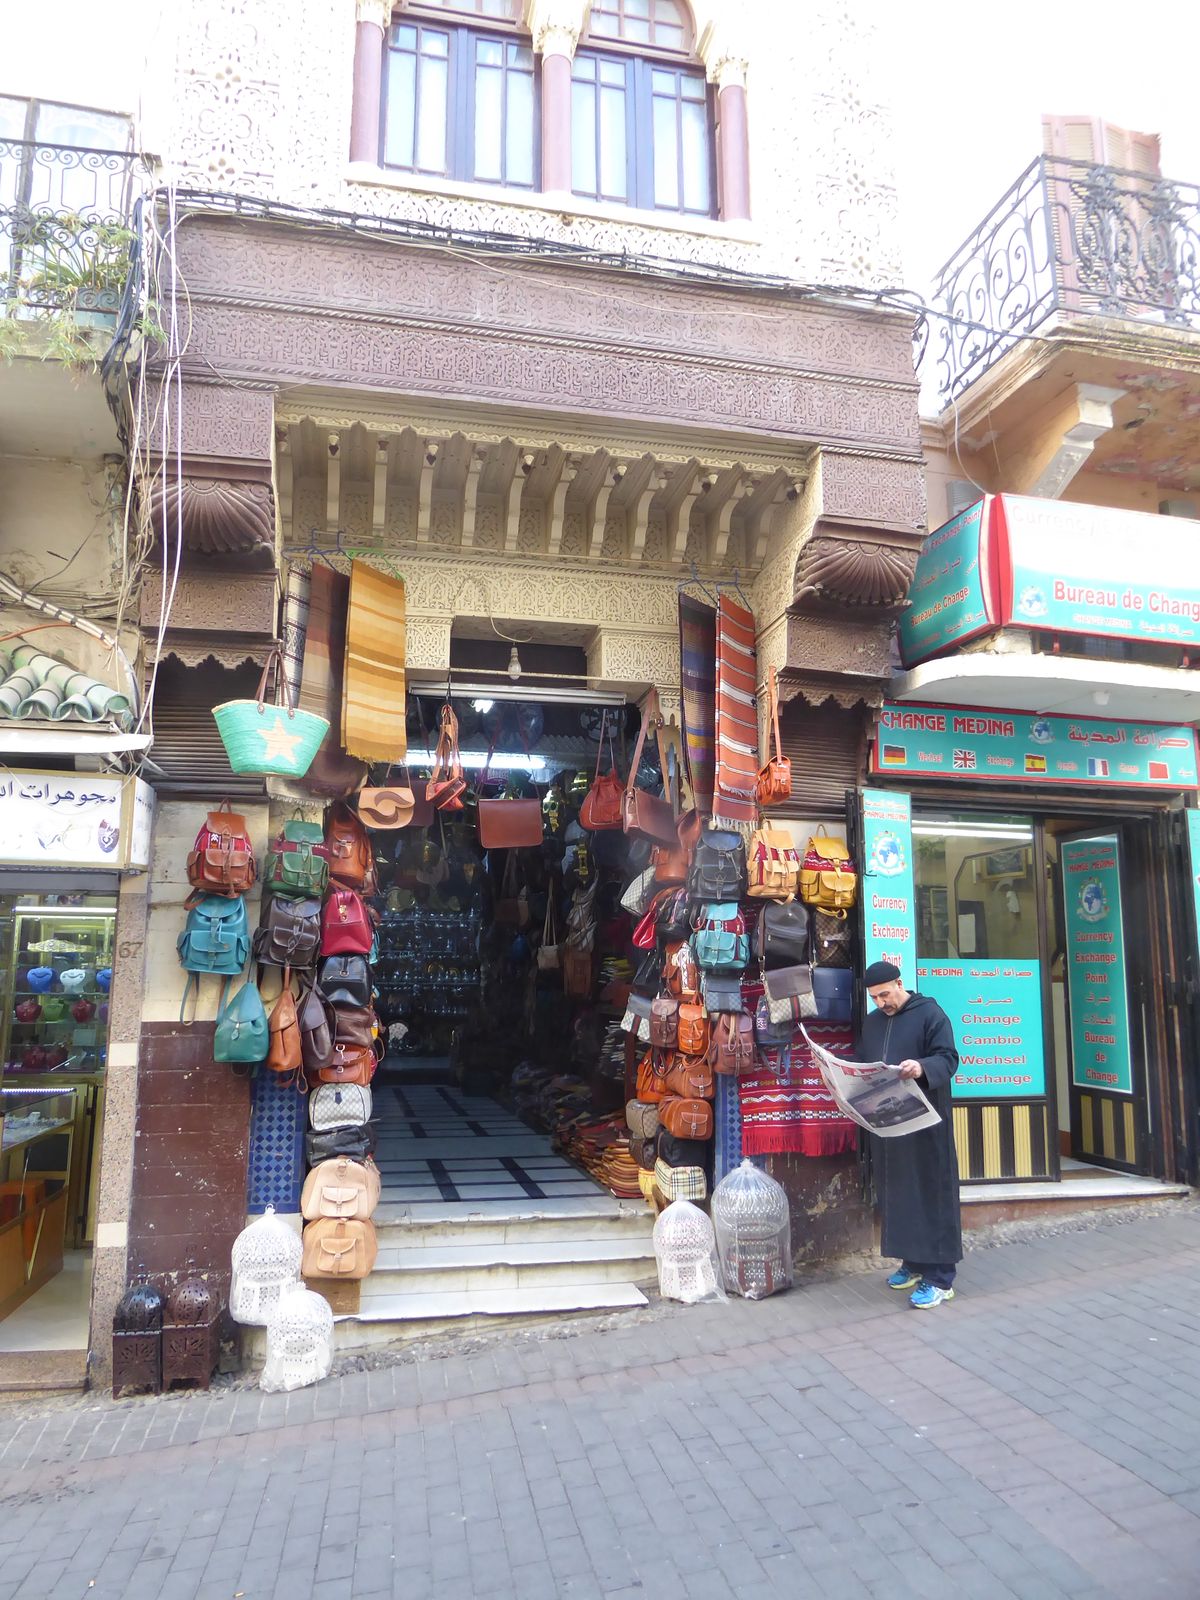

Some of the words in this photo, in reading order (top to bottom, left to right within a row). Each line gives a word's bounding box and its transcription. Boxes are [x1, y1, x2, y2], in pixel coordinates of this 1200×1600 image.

[1054, 580, 1116, 606] Bureau
[1122, 590, 1142, 609] de
[911, 609, 933, 628] Bureau
[933, 601, 942, 612] de
[942, 587, 970, 608] Change
[880, 711, 946, 732] CHANGE
[953, 717, 1014, 737] MEDINA
[1067, 724, 1127, 746] المدينة
[1133, 729, 1190, 750] صرافة
[872, 894, 907, 913] Currency
[872, 923, 909, 942] Exchange
[1076, 932, 1114, 943] Currency
[119, 941, 144, 959] 67
[1076, 952, 1117, 965] Exchange
[931, 968, 963, 977] MEDINA
[1085, 973, 1108, 984] Point
[967, 994, 1013, 1007] صرف
[961, 1014, 1021, 1026] Change
[962, 1035, 1022, 1045] Cambio
[1085, 1031, 1116, 1045] Bureau
[960, 1055, 1027, 1065] Wechsel
[1096, 1052, 1106, 1063] de
[955, 1075, 1032, 1085] Exchange
[1086, 1069, 1118, 1084] Change
